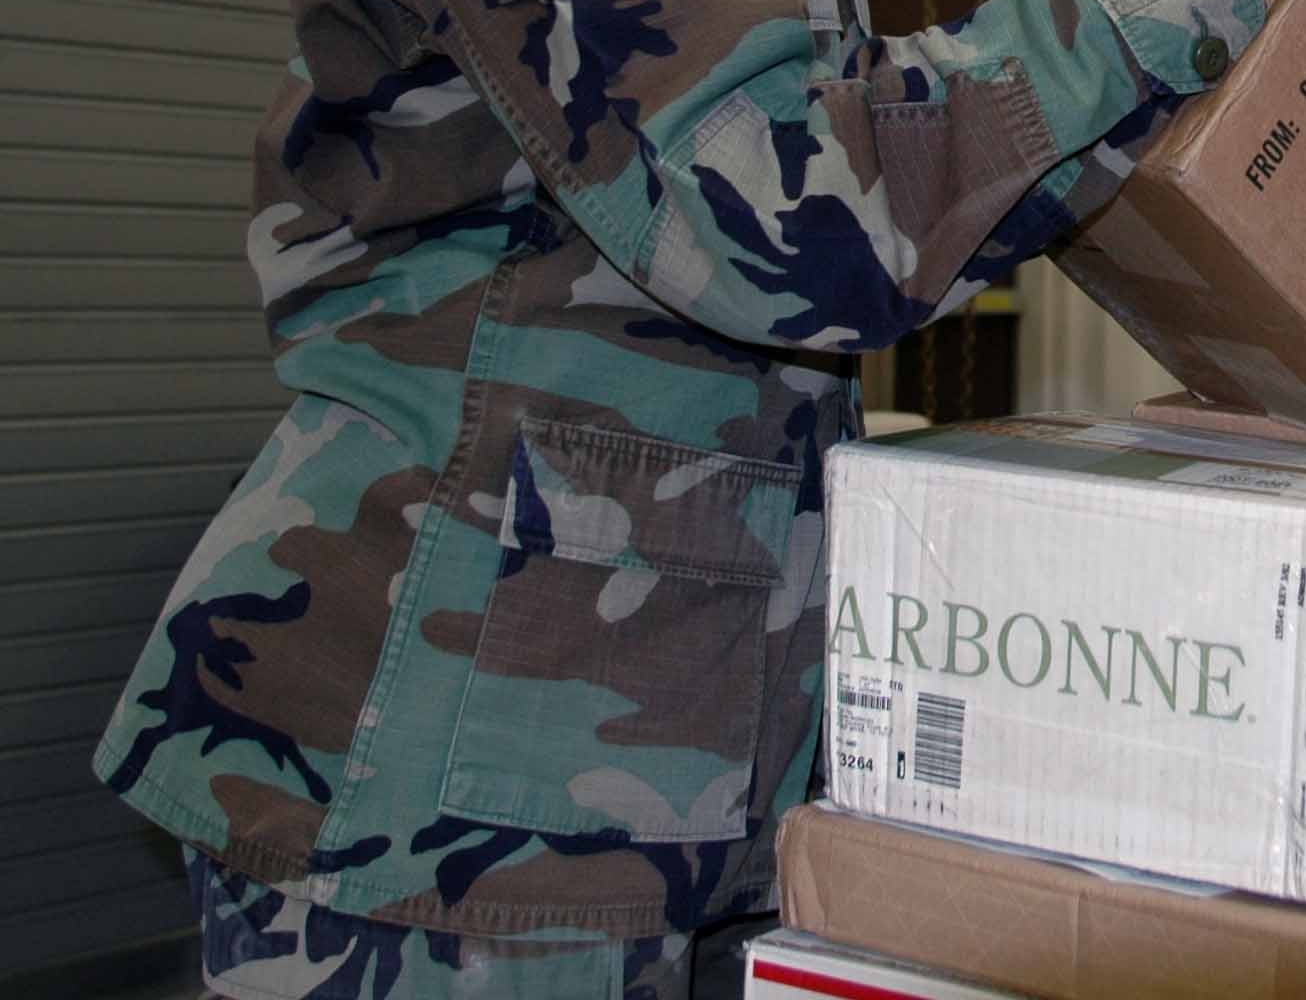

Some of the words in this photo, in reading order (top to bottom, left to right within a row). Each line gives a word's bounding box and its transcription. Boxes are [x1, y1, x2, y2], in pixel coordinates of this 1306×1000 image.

[1245, 119, 1301, 191] FROM:
[828, 584, 1248, 724] ARBONNE
[838, 752, 874, 772] 3264
